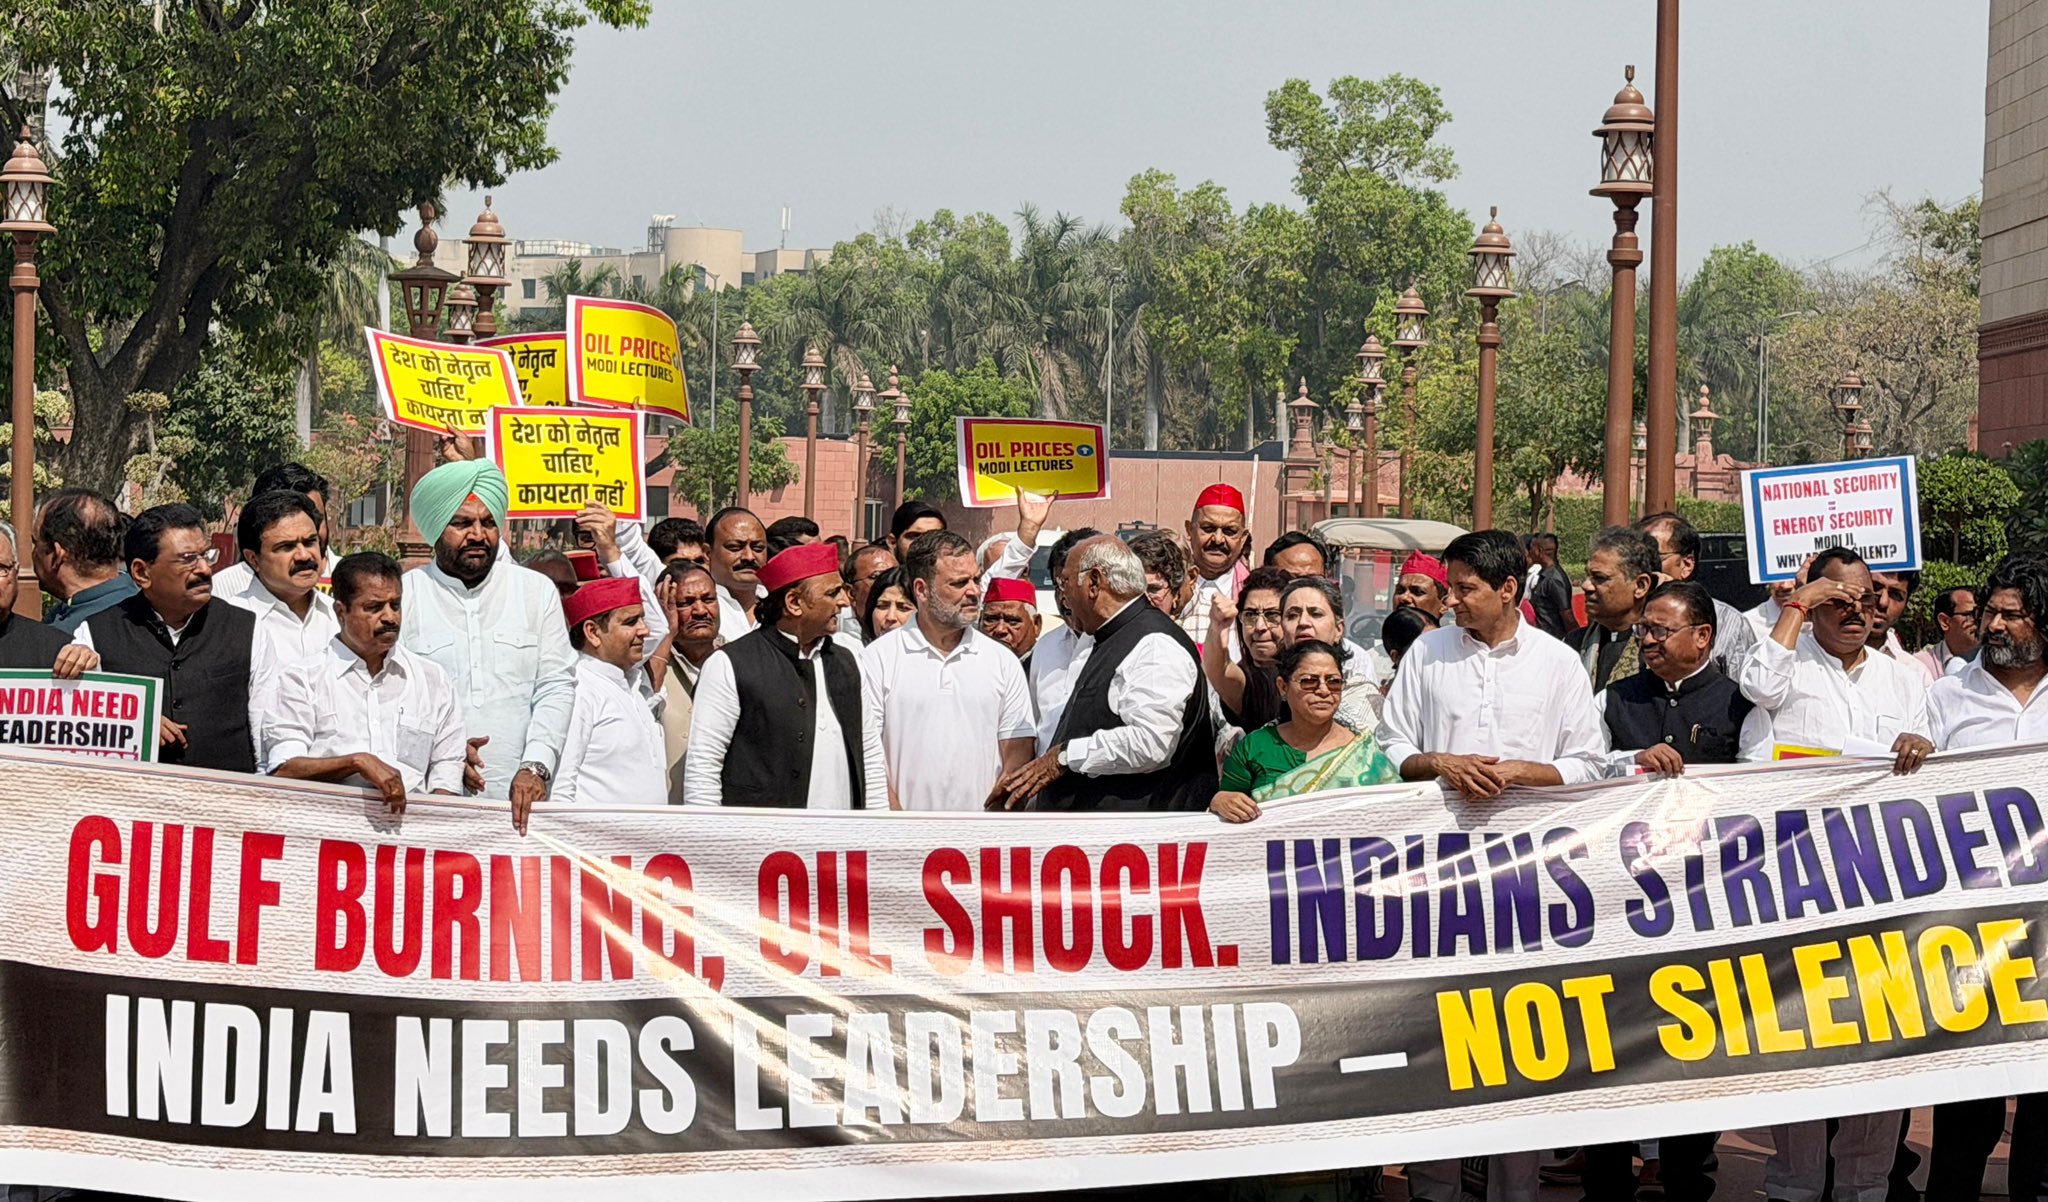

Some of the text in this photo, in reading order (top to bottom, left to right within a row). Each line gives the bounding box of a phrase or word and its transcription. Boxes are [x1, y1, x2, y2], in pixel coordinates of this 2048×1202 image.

[389, 343, 416, 369] देश
[418, 351, 442, 374] को
[443, 353, 492, 384] नेतृत्व
[518, 344, 557, 378] नेतृत्व
[585, 333, 672, 366] OIL PRICES
[586, 356, 674, 383] MODI LECTURES
[418, 377, 472, 404] चाहिए,
[403, 397, 464, 426] कायरता
[510, 417, 621, 454] देश को नेतृत्व
[541, 447, 599, 477] चाहिए,
[976, 442, 1075, 459] OIL PRICES
[978, 459, 1074, 475] MODI LECTURES
[516, 479, 627, 507] कायरता नहीं
[1762, 472, 1897, 501] NATIONAL SECURITY
[1773, 508, 1893, 536] ENERGY SECURITY
[1814, 533, 1842, 549] MODI
[1776, 553, 1802, 568] WHY
[0, 688, 139, 720] NDIA NEED
[0, 720, 138, 752] EADERSHIP,
[66, 786, 2048, 993] GULF BURNING, OIL SHOCK. INDIANS STRANDED
[105, 994, 357, 1135] INDIA
[393, 1015, 696, 1138] NEEDS
[733, 1002, 1301, 1131] LEADERSHIP
[1435, 974, 1615, 1091] NOT
[1648, 918, 2048, 1061] SILENCE
